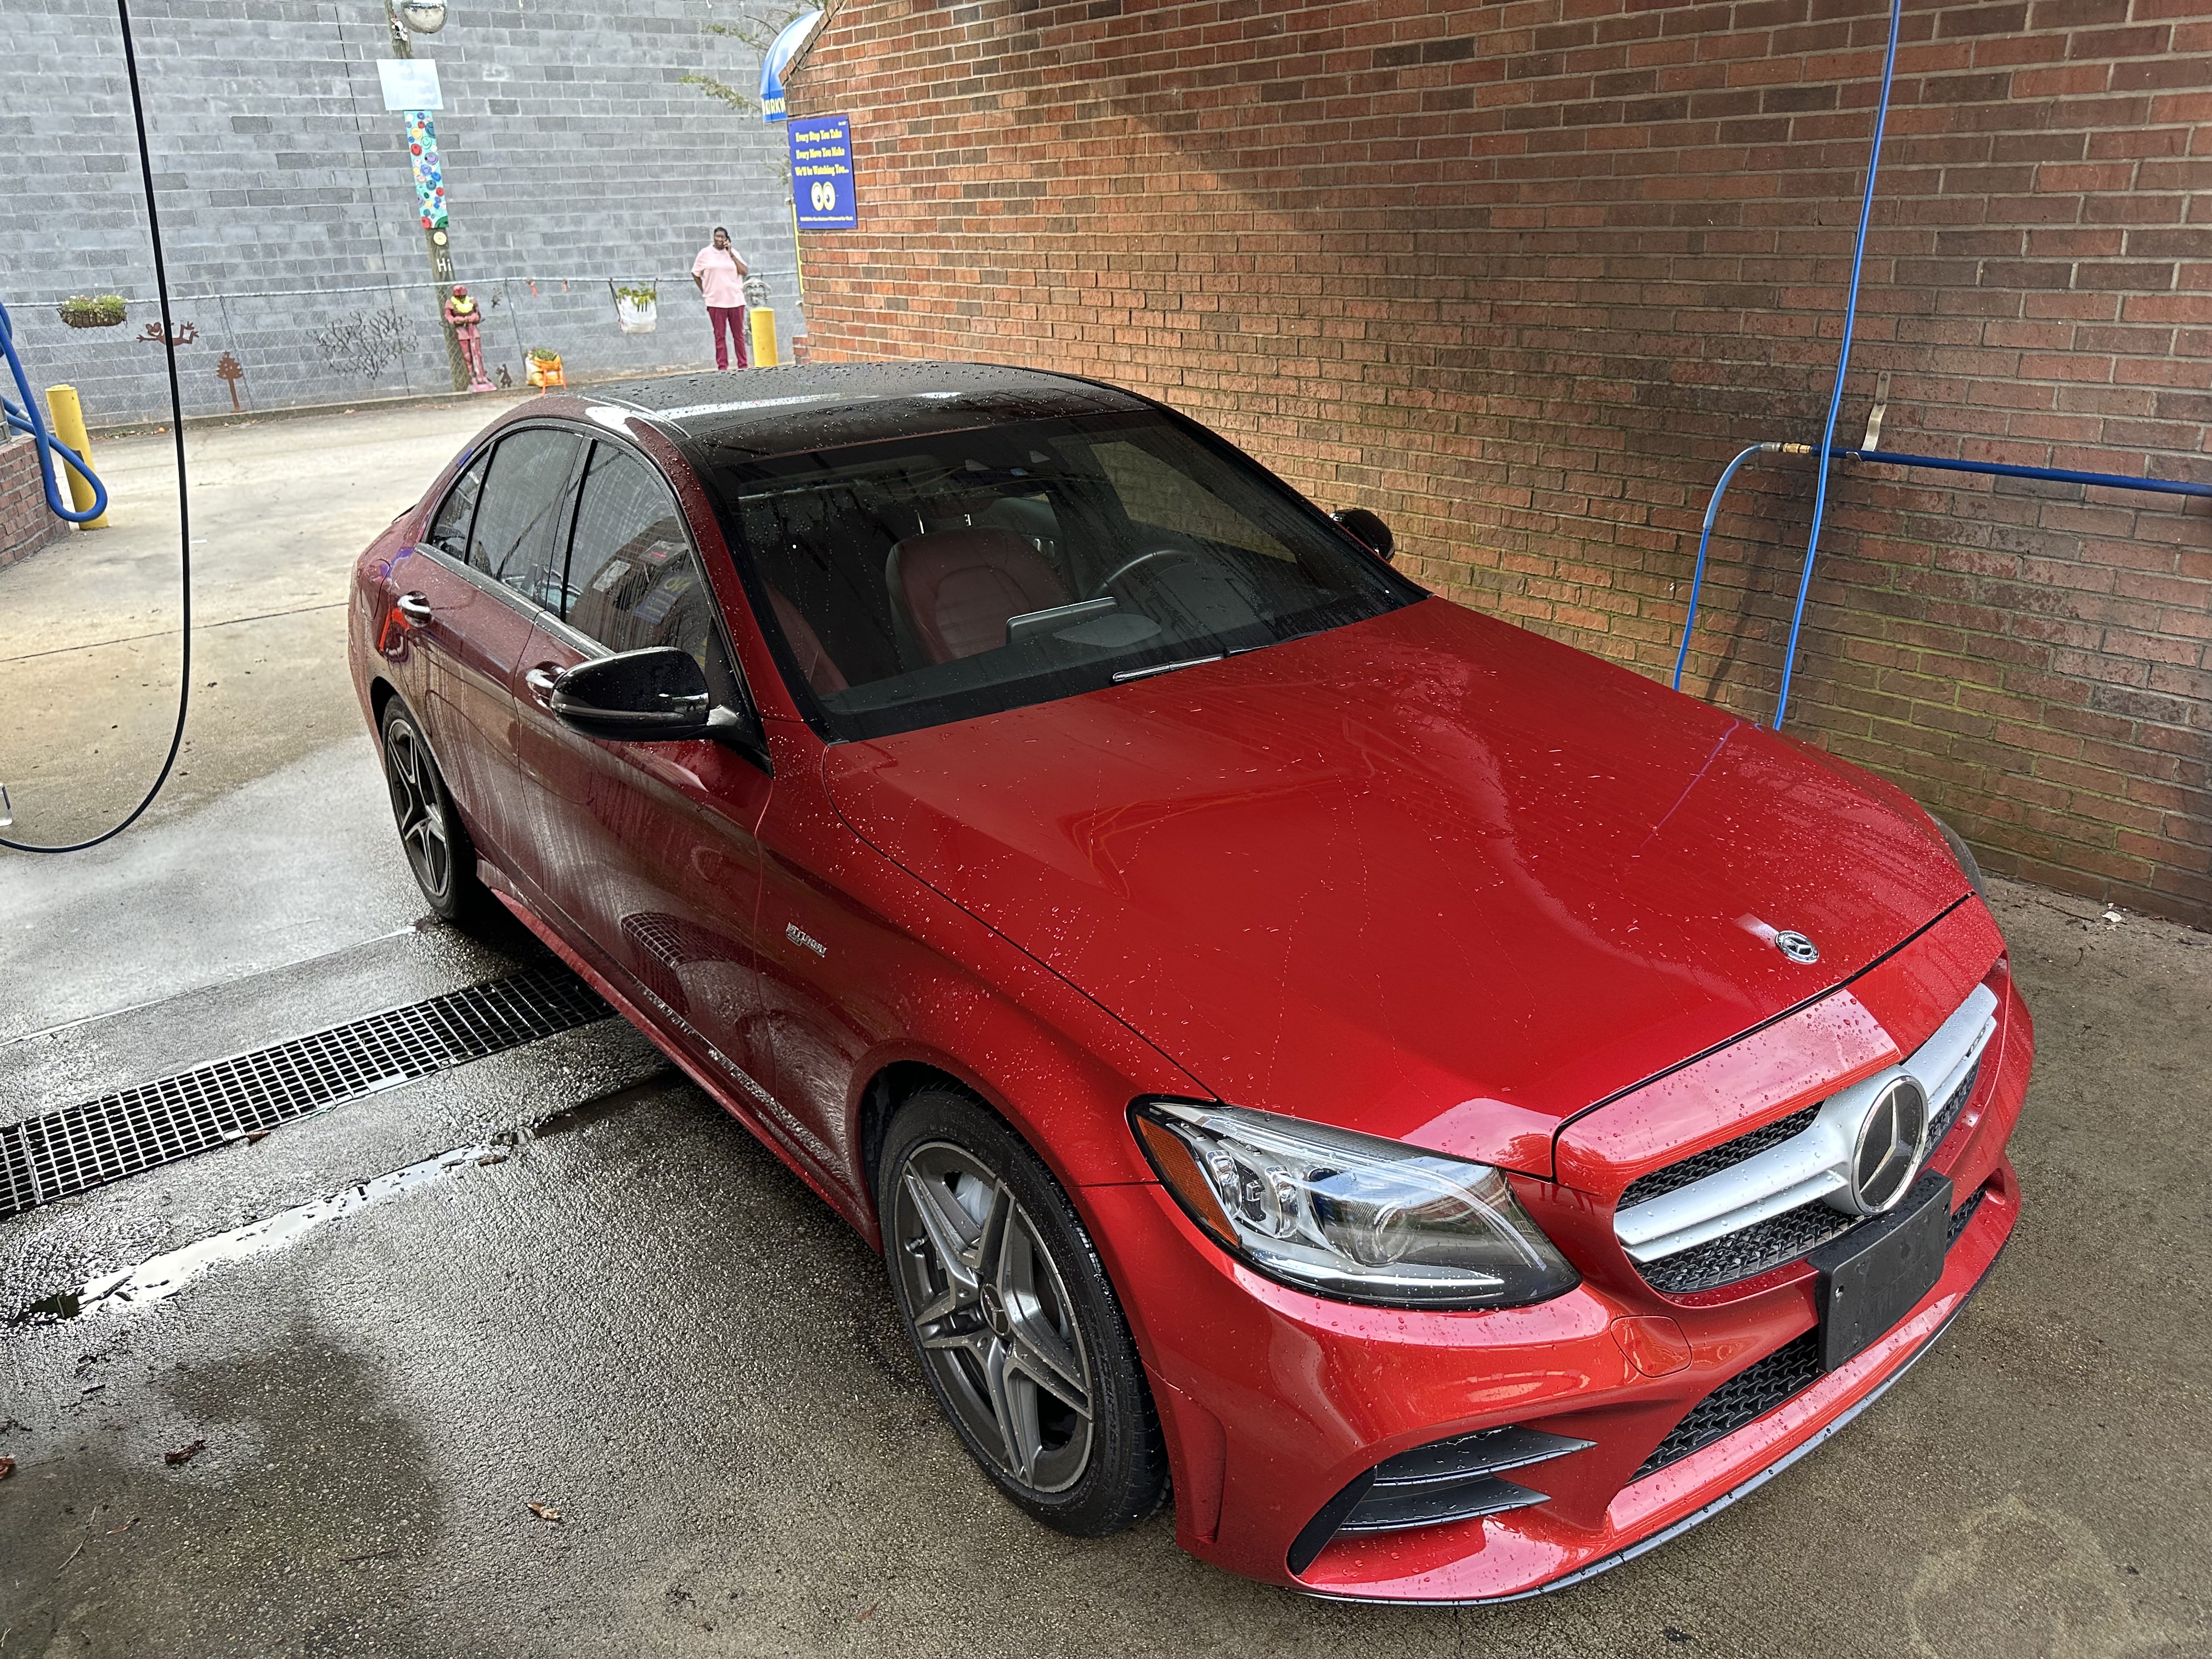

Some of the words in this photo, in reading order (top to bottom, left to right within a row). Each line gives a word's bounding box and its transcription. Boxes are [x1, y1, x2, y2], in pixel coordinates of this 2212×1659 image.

[795, 132, 809, 143] Every
[820, 130, 830, 139] You
[830, 129, 842, 139] Take
[796, 150, 809, 160] Every
[809, 149, 822, 158] Move
[821, 148, 831, 157] You
[831, 146, 845, 156] Make
[795, 167, 807, 176] We'll
[812, 165, 835, 176] Watching
[437, 258, 452, 272] Hi
